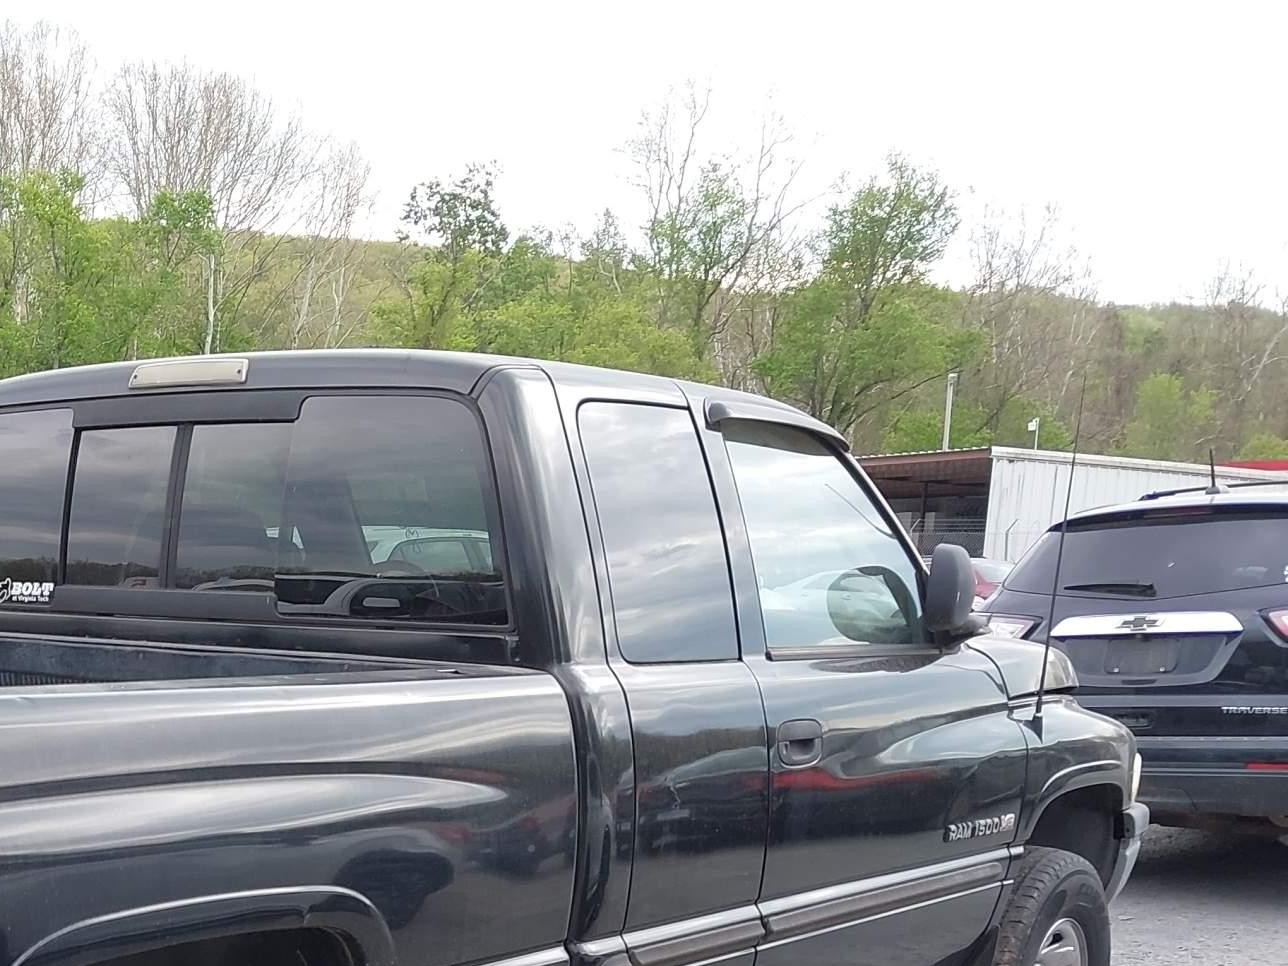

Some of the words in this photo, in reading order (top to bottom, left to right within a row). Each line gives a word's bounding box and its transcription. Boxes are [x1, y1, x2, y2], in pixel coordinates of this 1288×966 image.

[11, 581, 54, 595] BOLT
[18, 595, 37, 603] Virginia
[1221, 706, 1288, 714] TRAVERSE
[947, 821, 972, 841] RAM
[974, 816, 1000, 836] 1500
